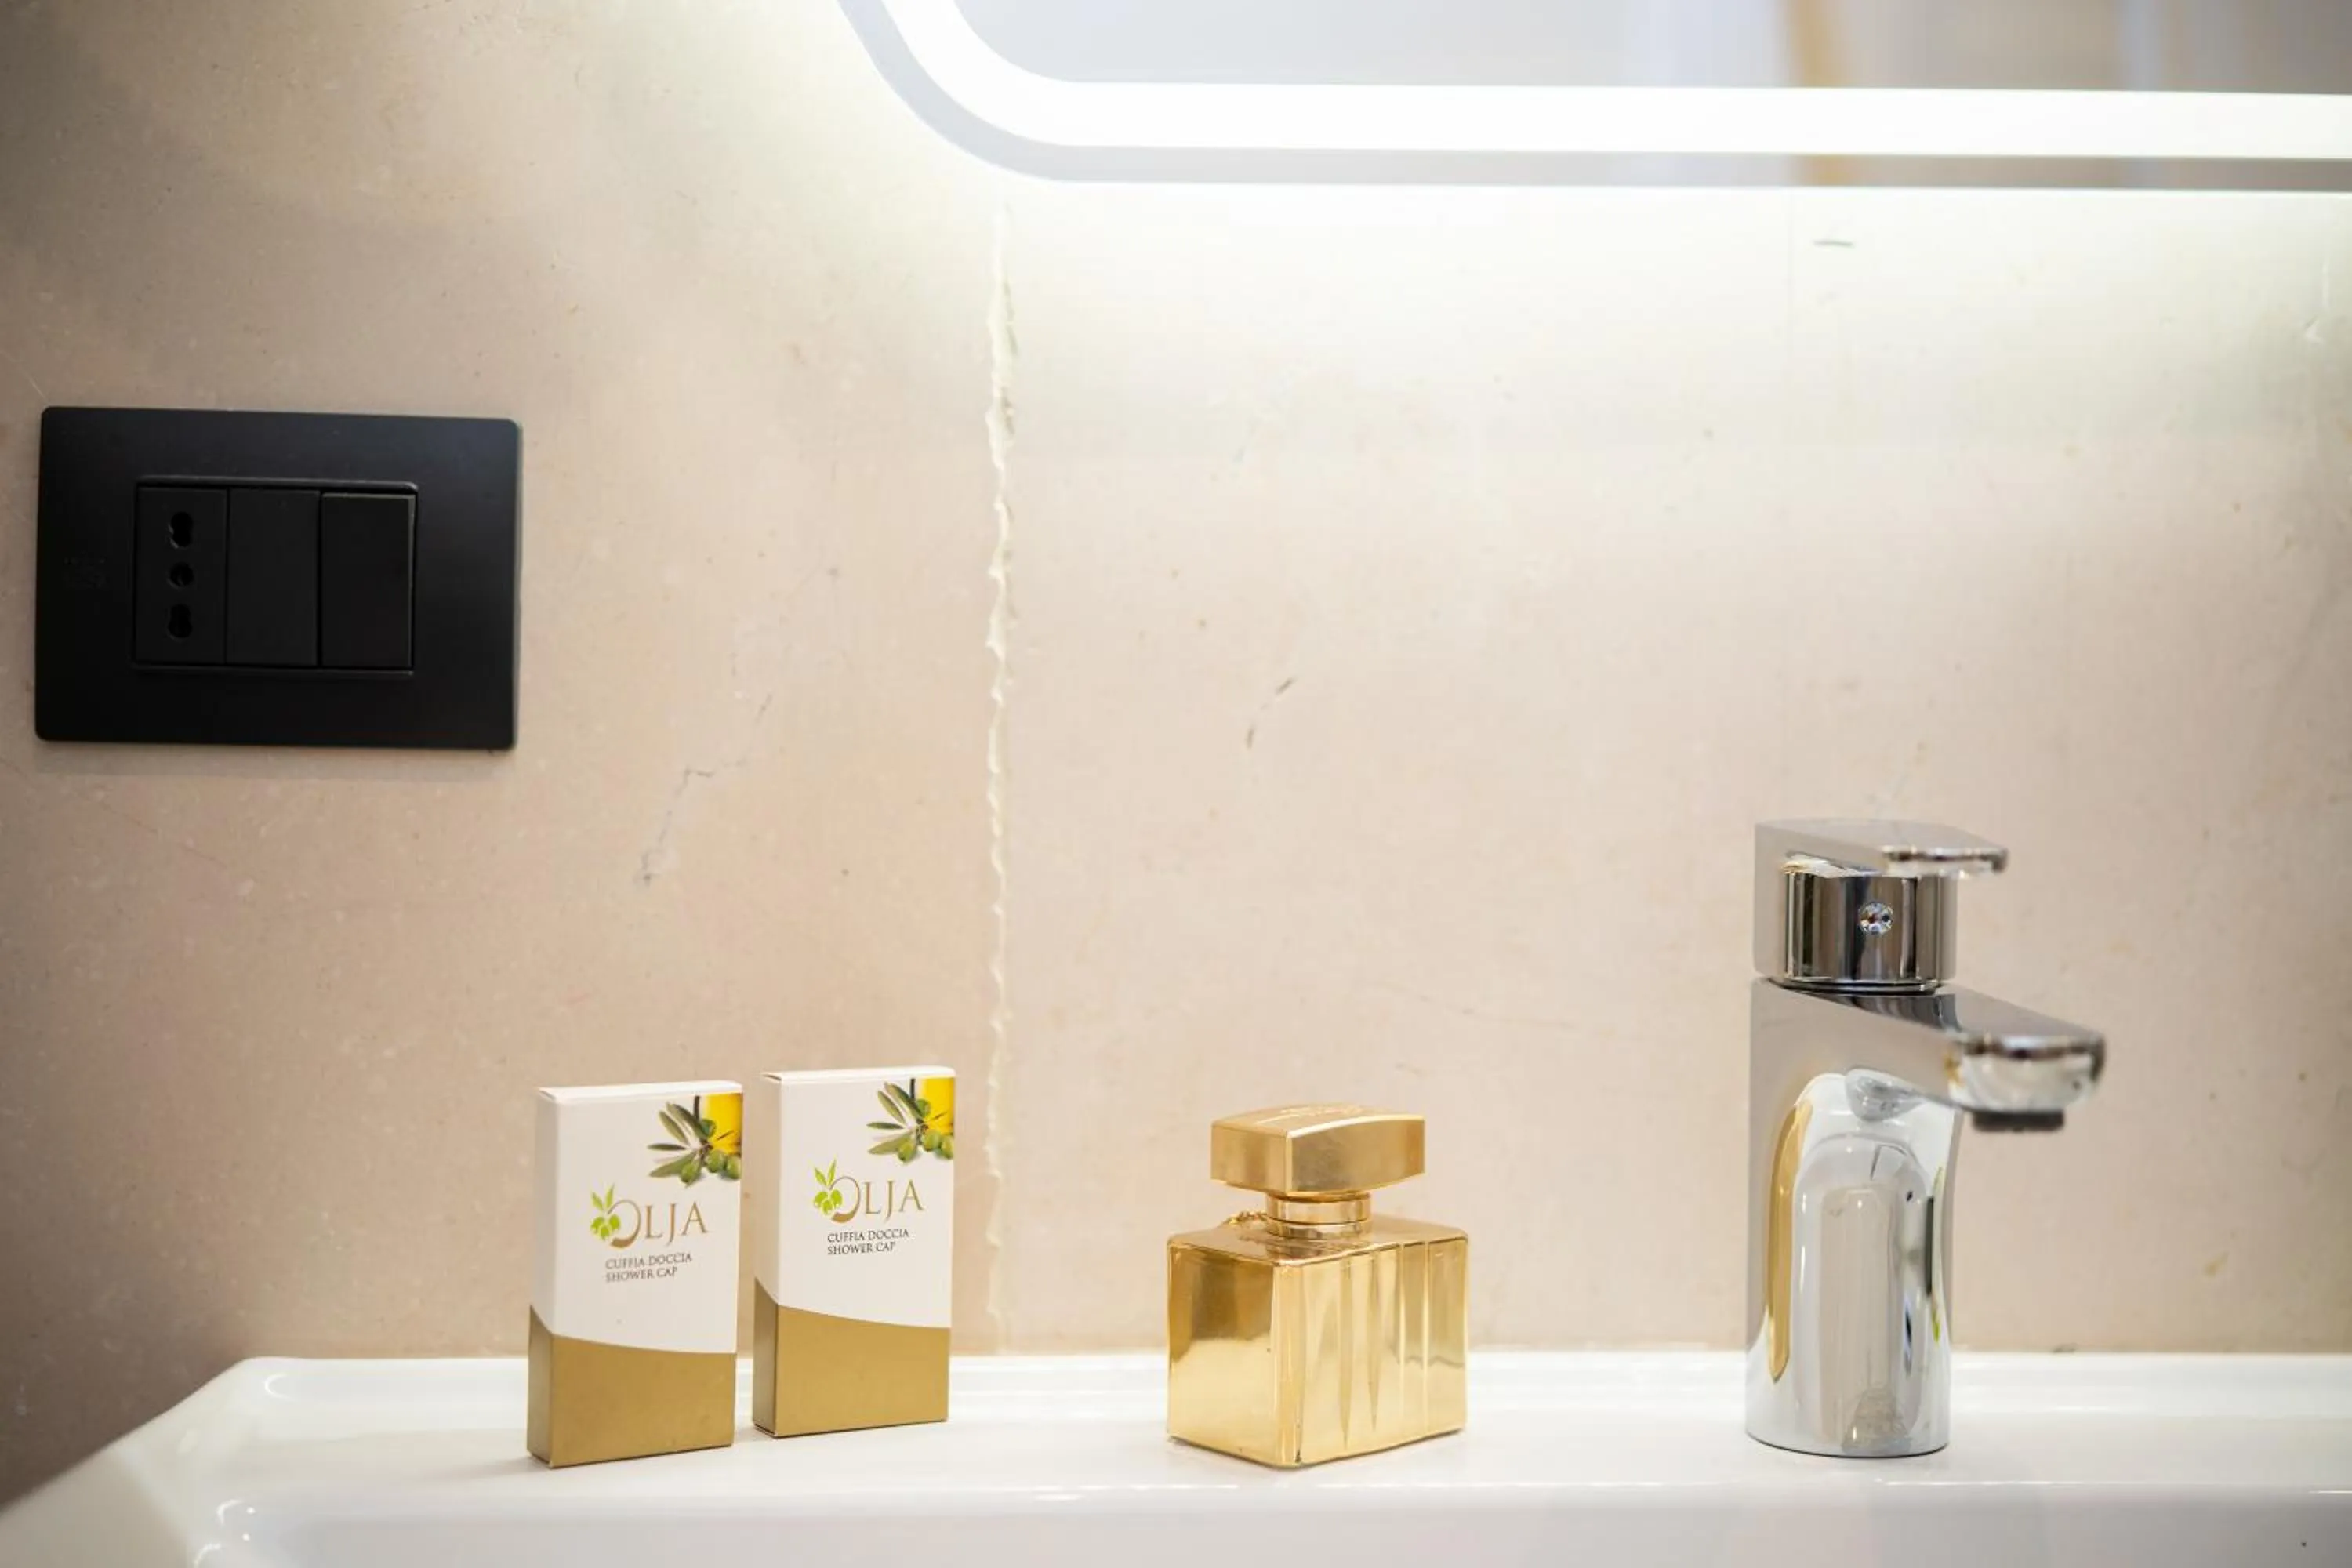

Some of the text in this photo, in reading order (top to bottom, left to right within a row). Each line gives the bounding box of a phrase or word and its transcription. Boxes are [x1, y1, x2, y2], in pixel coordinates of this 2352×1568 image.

[829, 1176, 924, 1223] OLJA
[607, 1199, 709, 1247] OLJA
[827, 1229, 909, 1243] CUFFIA DOCCIA
[827, 1241, 895, 1255] SHOWER CAP
[606, 1254, 692, 1269] CUFFIA DOCCIA
[606, 1267, 677, 1283] SHOWER CAP
